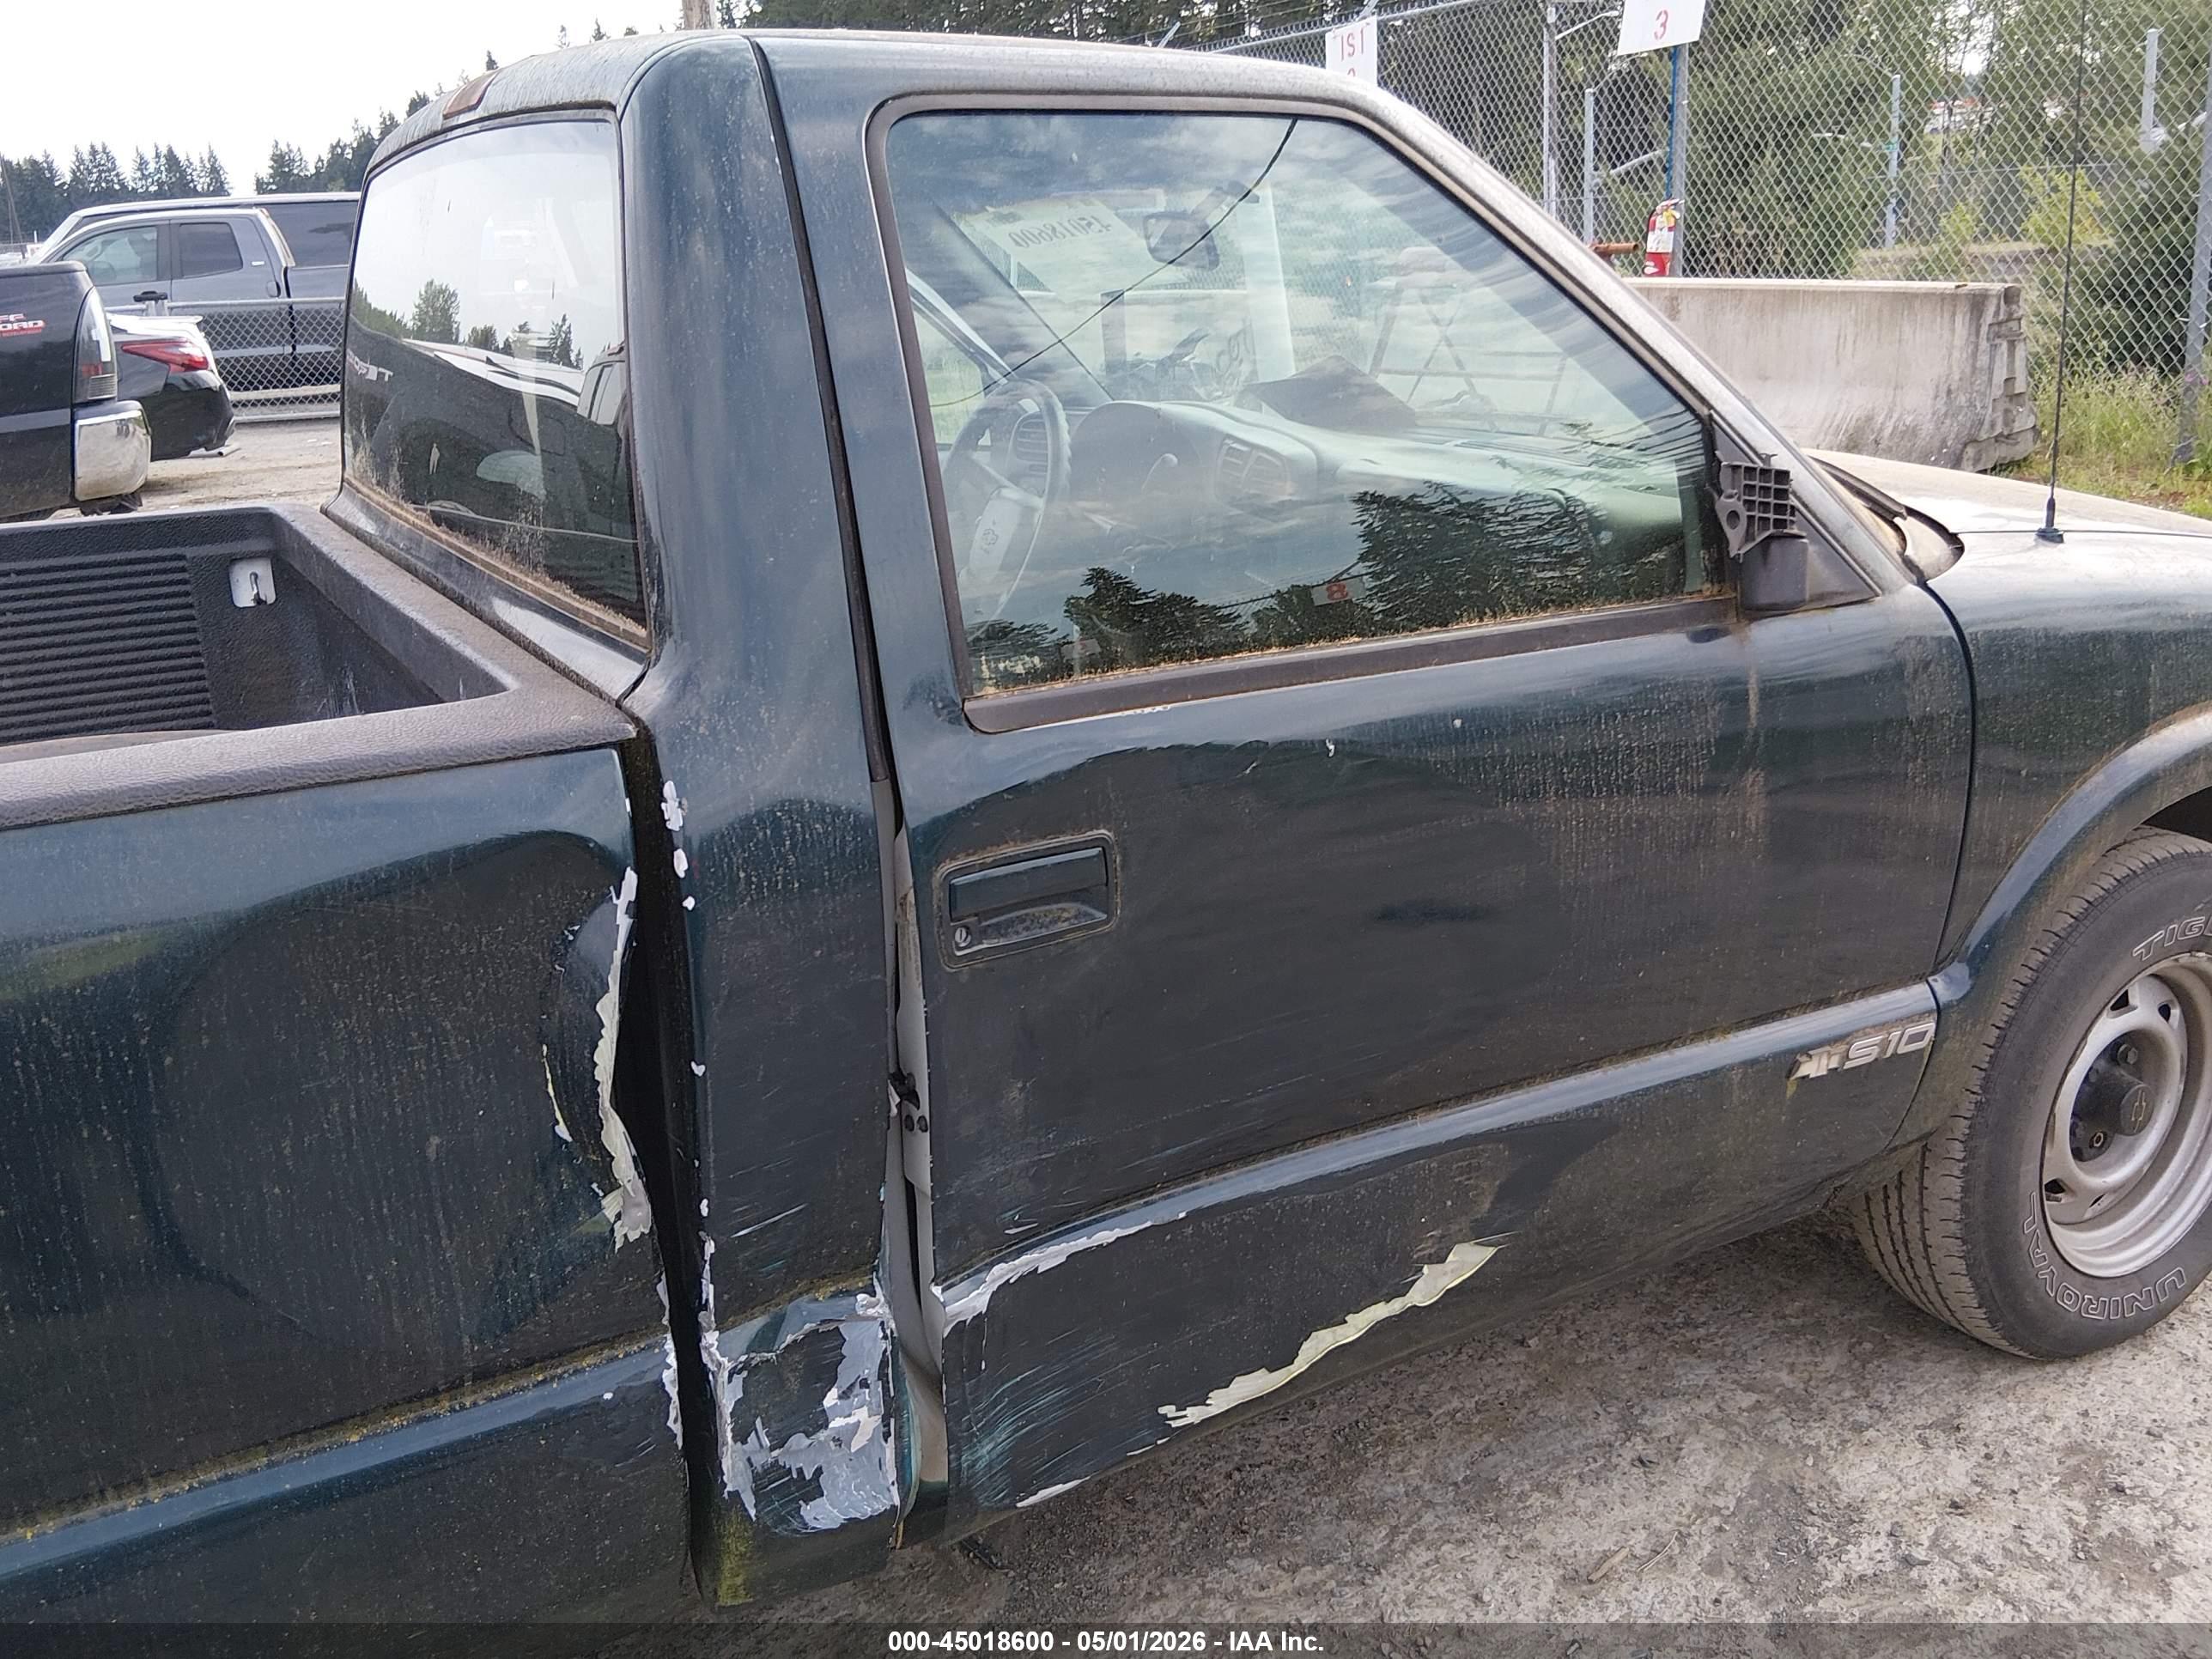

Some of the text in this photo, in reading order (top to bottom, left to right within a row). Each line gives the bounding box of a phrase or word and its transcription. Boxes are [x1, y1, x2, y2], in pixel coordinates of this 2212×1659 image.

[1654, 9, 1668, 40] 3
[1843, 1022, 1936, 1070] S10
[2023, 1191, 2186, 1320] UNIROYAL
